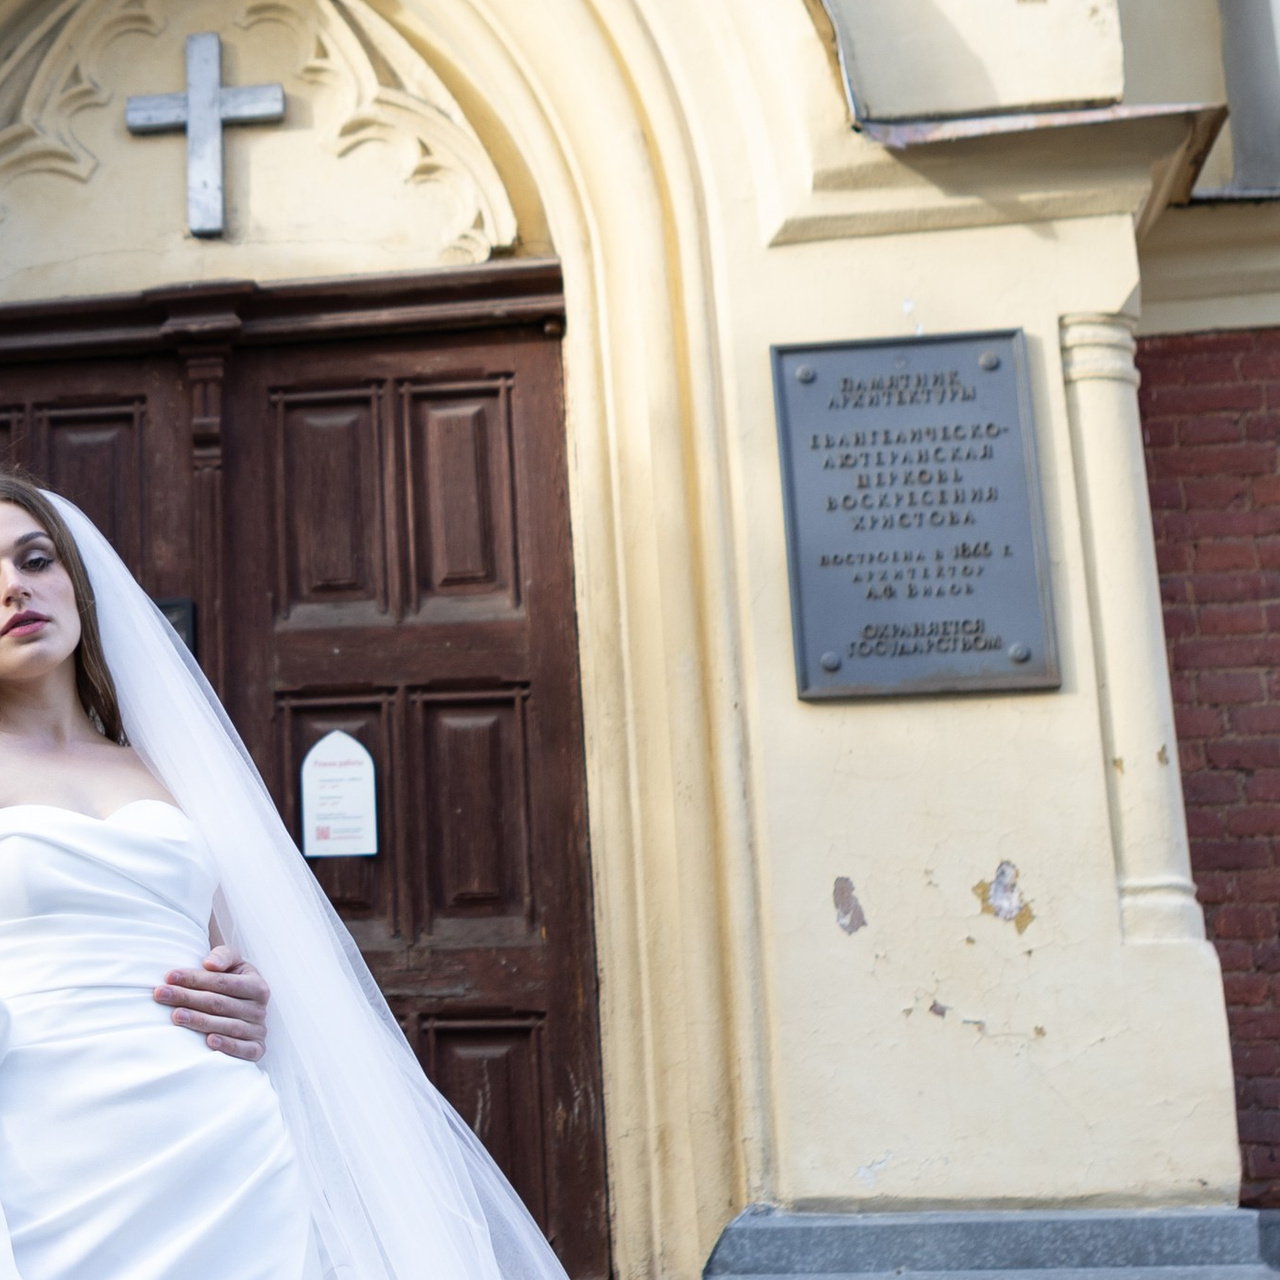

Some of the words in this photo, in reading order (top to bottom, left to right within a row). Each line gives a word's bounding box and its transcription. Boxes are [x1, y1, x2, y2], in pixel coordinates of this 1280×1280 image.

[840, 370, 962, 393] ПАМЯТНИК
[828, 386, 977, 410] АРХИТЕКТУРЫ
[810, 422, 1010, 450] ЕВАНГЕЛИЧЕСКО-
[823, 444, 994, 470] ЛЮТЕРАНСКАЯ
[856, 467, 963, 490] ЦЕРКОВЬ
[825, 486, 1000, 512] ВОСКРЕСЕНИЯ
[851, 509, 977, 532] ХРИСТОВА
[819, 549, 926, 568] ПОСТРОЕНА
[852, 565, 985, 585] АРХИТЕКТОР
[862, 618, 986, 641] ОХРАНЯЕТСЯ
[848, 634, 1003, 659] ГОСУДАРСТВОМ
